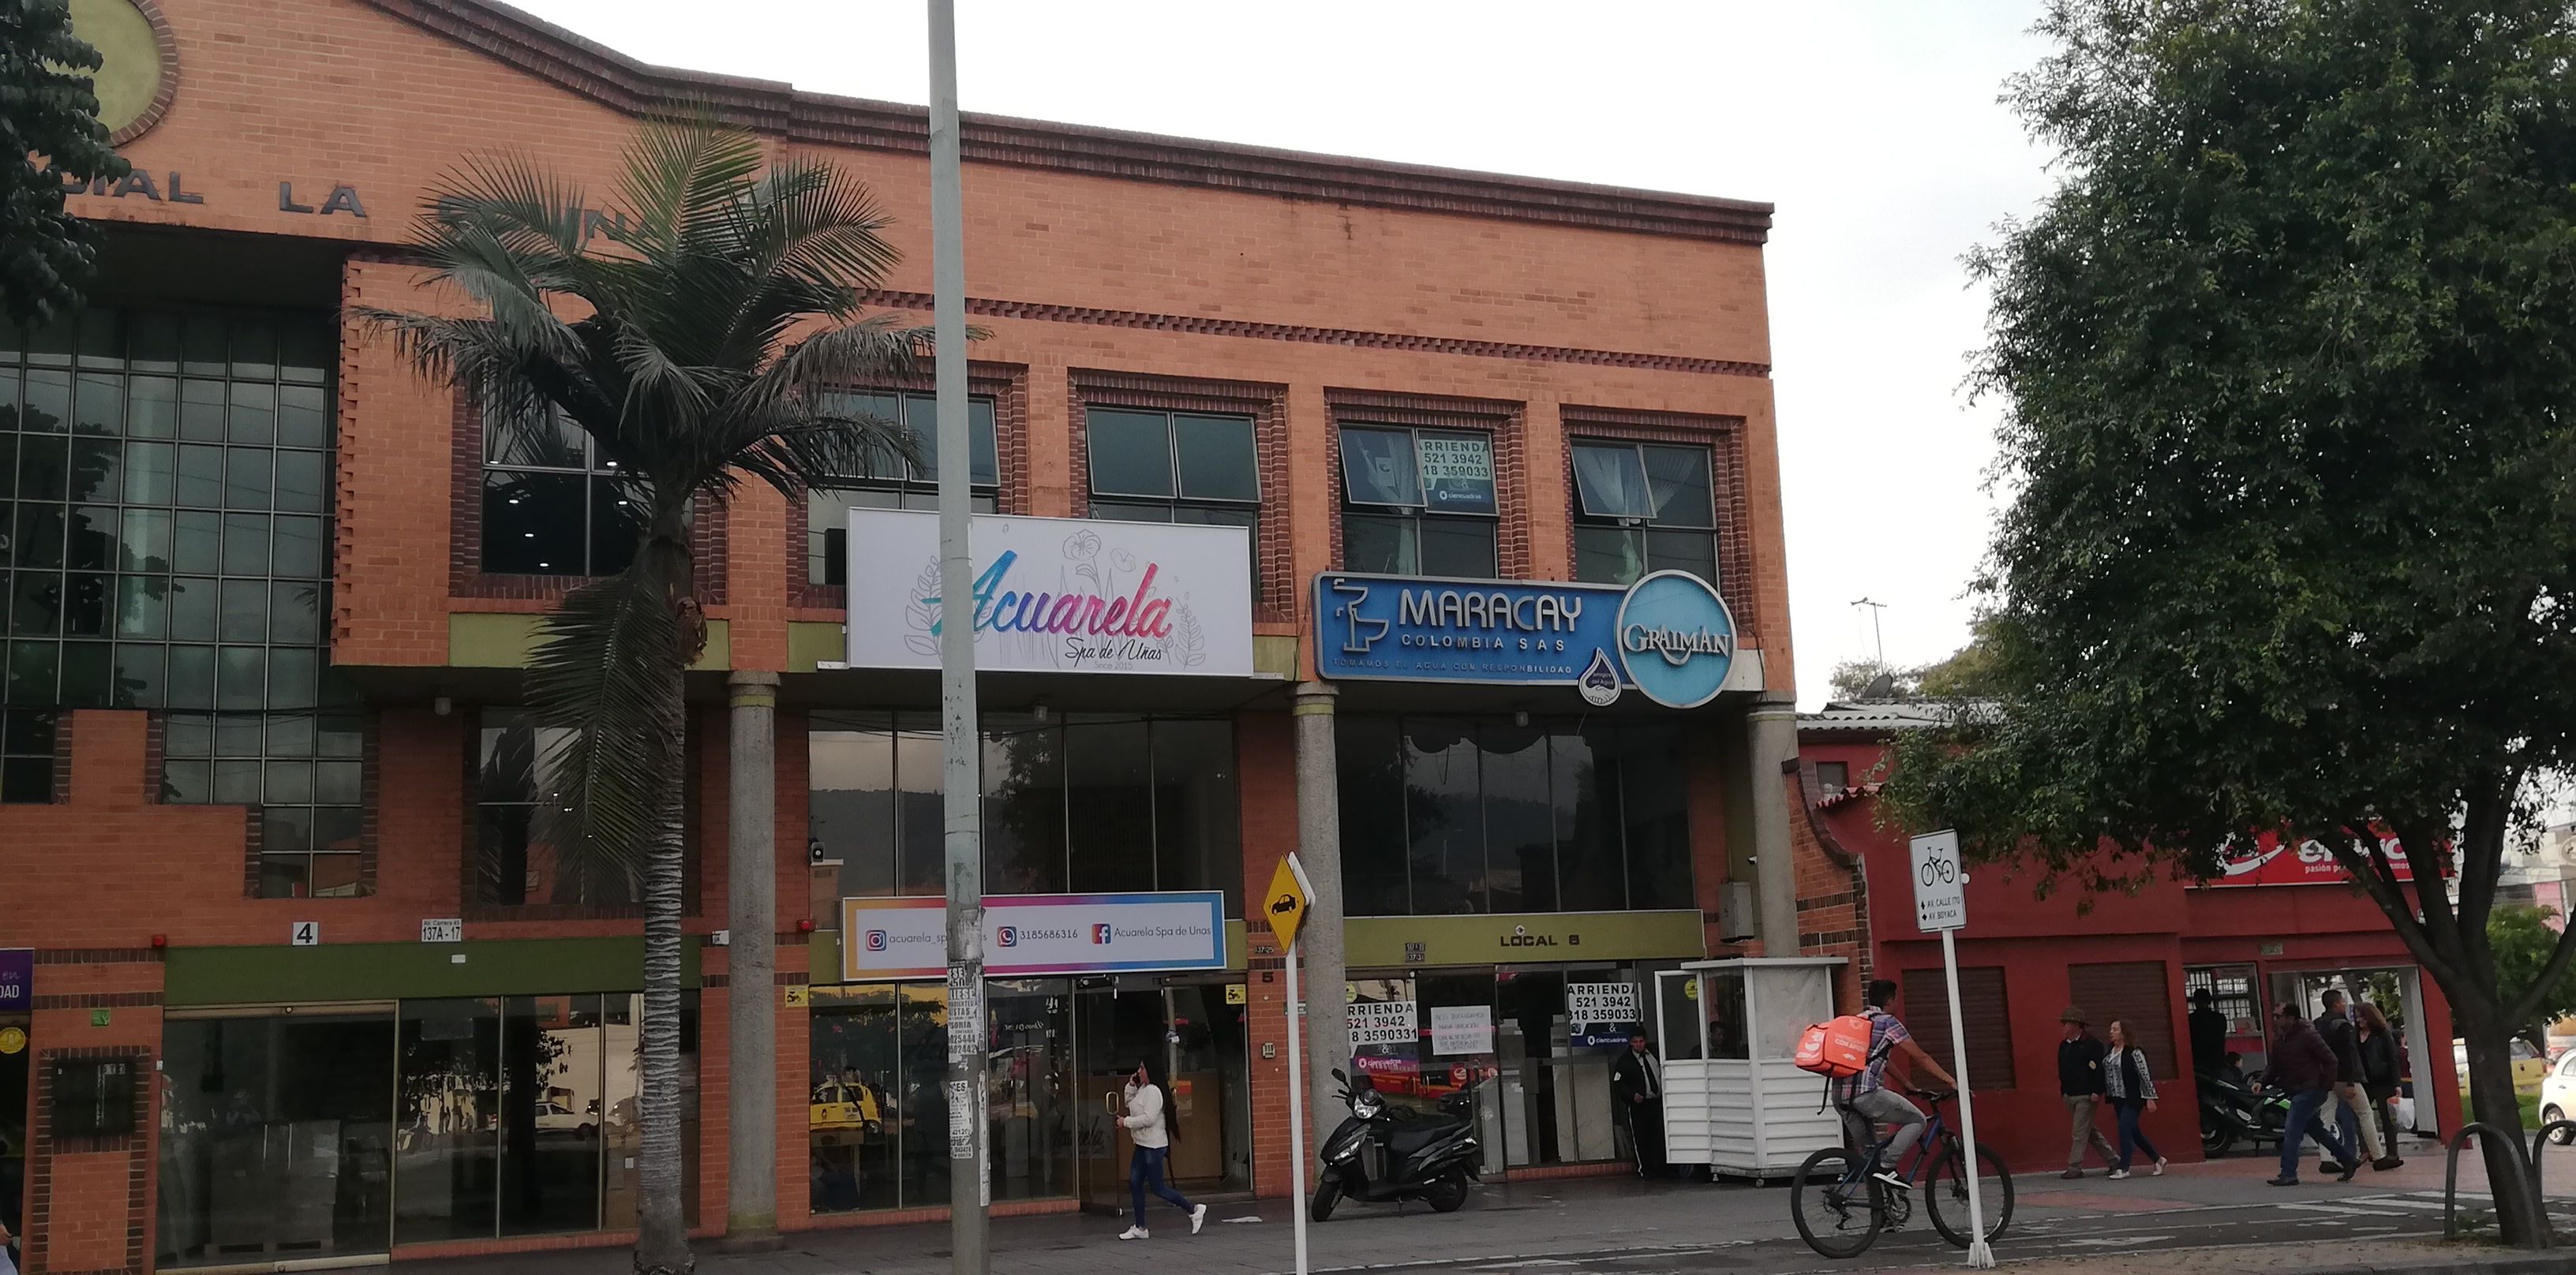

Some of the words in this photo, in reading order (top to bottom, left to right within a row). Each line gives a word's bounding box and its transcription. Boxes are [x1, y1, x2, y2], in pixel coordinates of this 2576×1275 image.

[279, 181, 368, 219] LA
[1425, 453, 1447, 464] 521
[1452, 454, 1481, 464] 3942
[1423, 465, 1437, 475] 18
[1443, 466, 1488, 477] 359033
[921, 549, 1173, 638] Acuarela
[1398, 589, 1582, 632] MARACAY
[1402, 634, 1503, 649] COLOMBIA
[1065, 637, 1095, 667] Spa
[1099, 640, 1114, 659] de
[1416, 661, 1447, 670] AGUA
[296, 922, 313, 944] 4
[423, 926, 444, 940] 137A
[451, 926, 461, 940] 17
[1020, 929, 1078, 940] 3185686316
[1114, 926, 1154, 937] Acuarela
[1156, 926, 1174, 939] Spa
[1175, 925, 1187, 936] de
[1500, 935, 1558, 947] LOCAL
[1576, 997, 1597, 1008] 521
[1602, 996, 1631, 1008] 3942
[1347, 1004, 1414, 1016] RRIENDA
[1346, 1018, 1368, 1029] 521
[1374, 1015, 1406, 1028] 3942
[1364, 1028, 1417, 1041] 3590331
